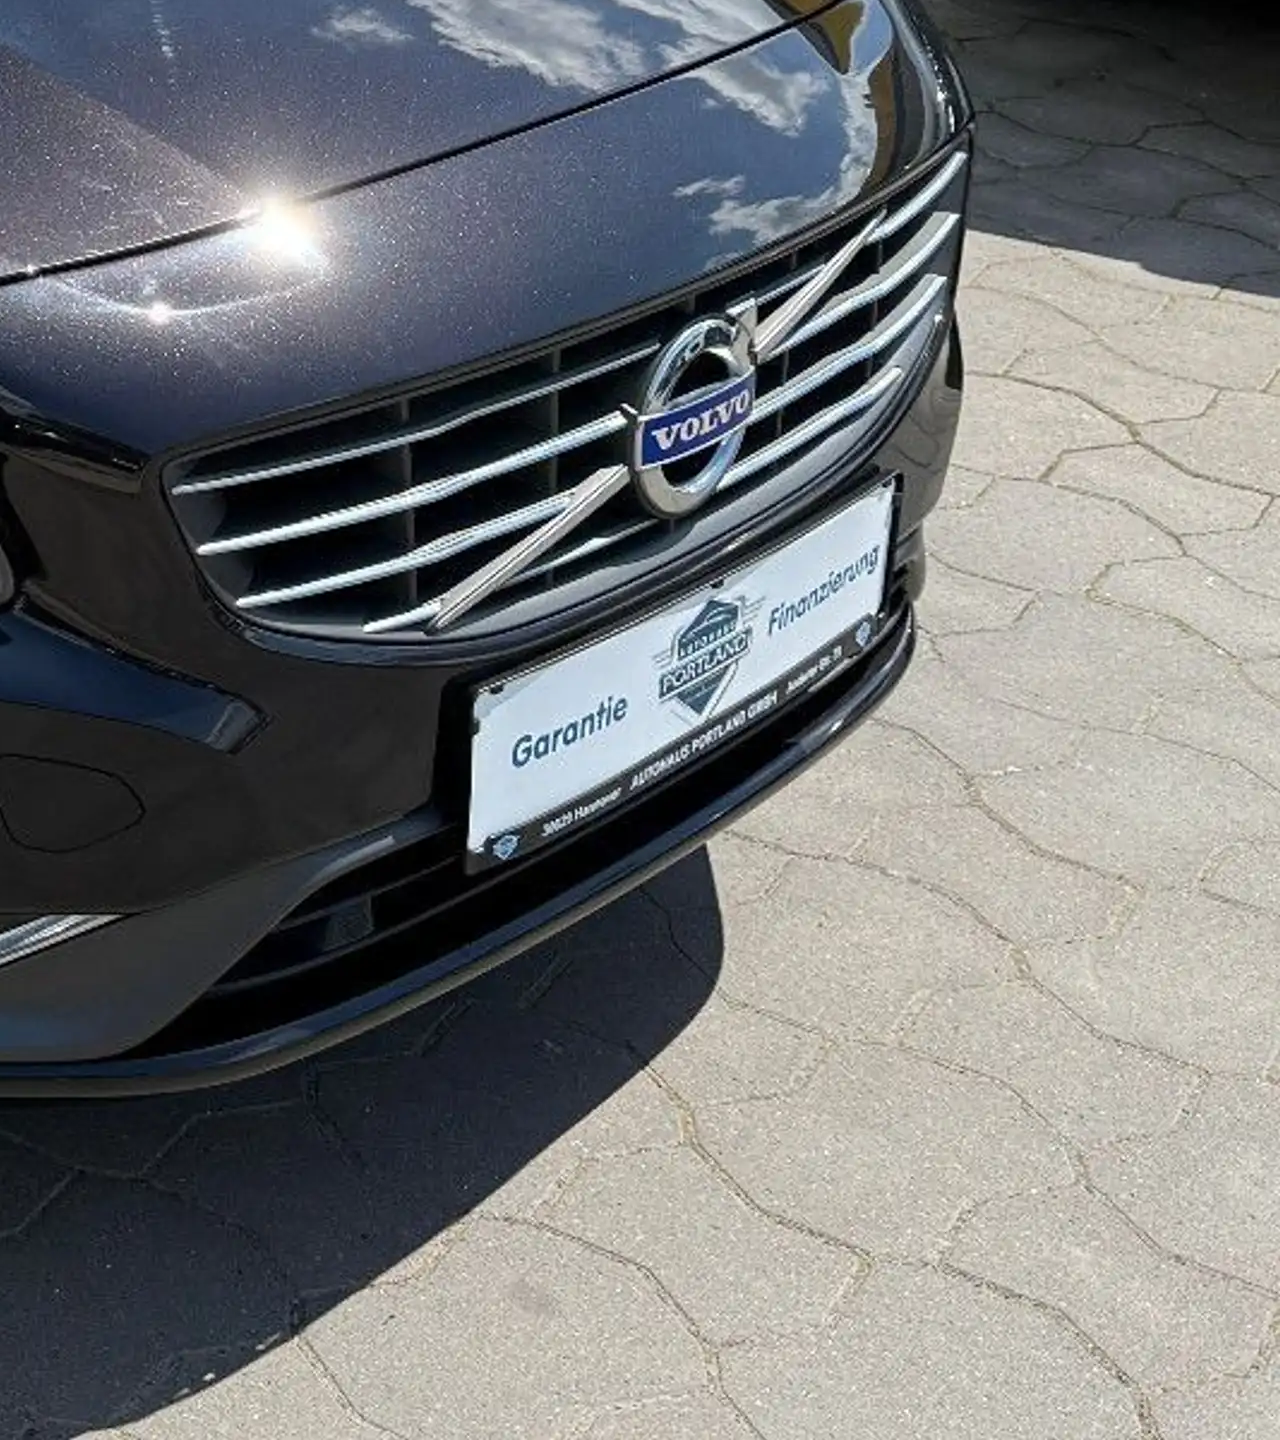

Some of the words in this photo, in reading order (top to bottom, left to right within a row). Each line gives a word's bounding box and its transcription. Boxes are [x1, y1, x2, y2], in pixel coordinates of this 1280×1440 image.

[651, 388, 750, 451] VOLVO
[768, 544, 881, 638] Finanzierung
[661, 630, 749, 694] PORTLAND
[511, 695, 628, 769] Garantie
[691, 709, 746, 753] PORTLAND
